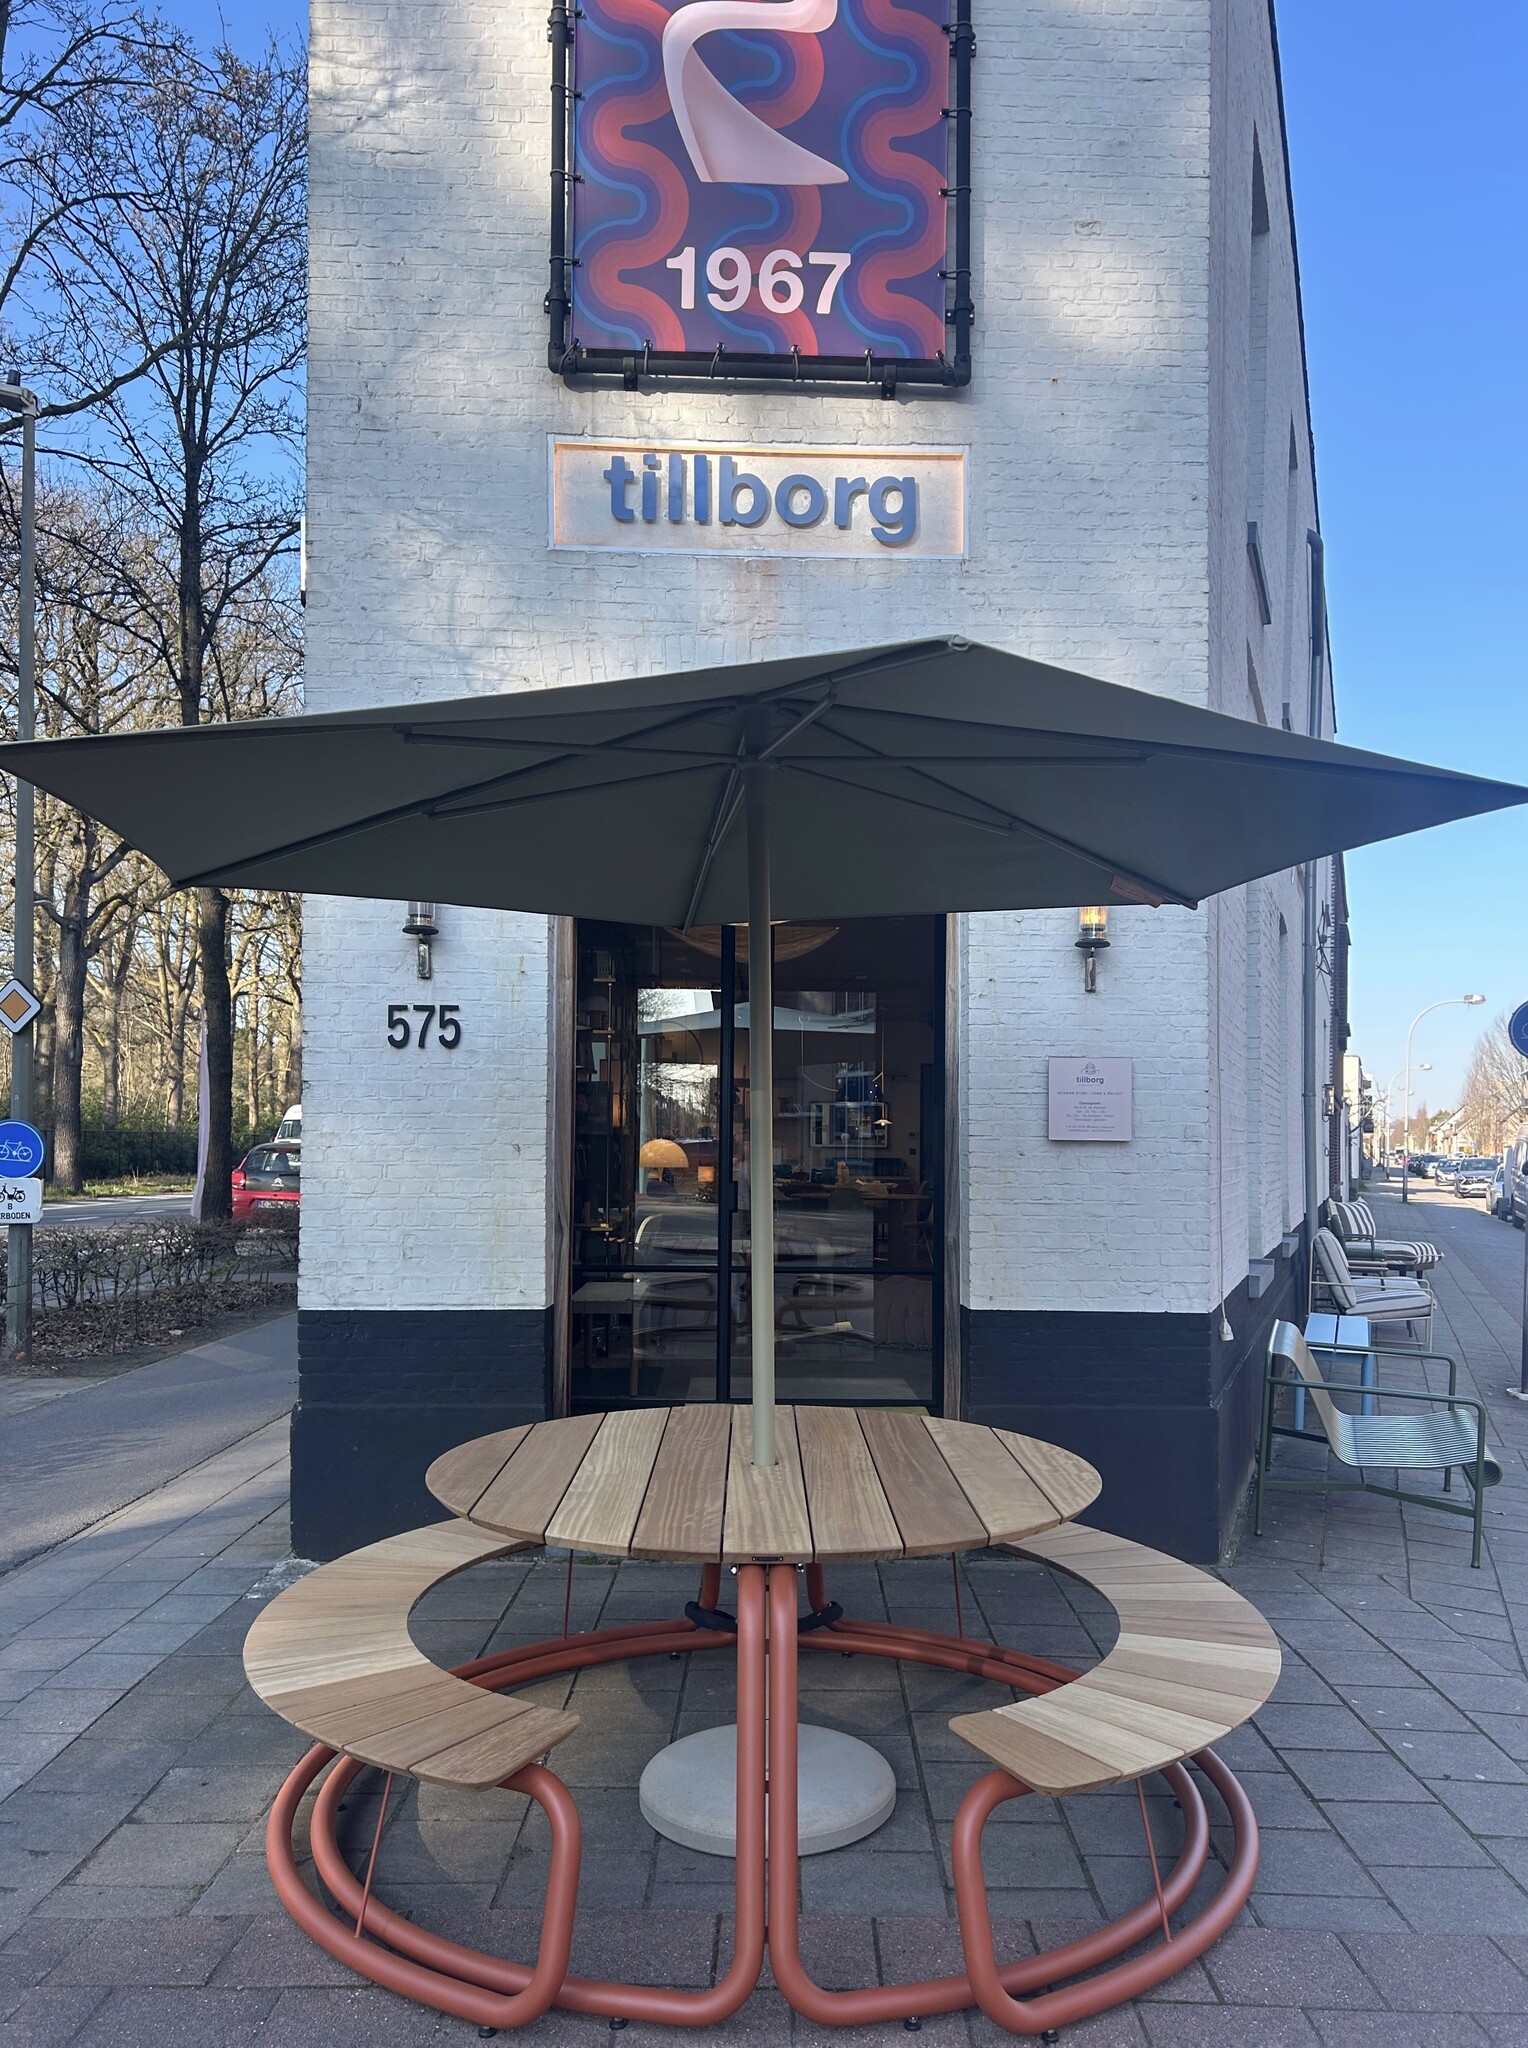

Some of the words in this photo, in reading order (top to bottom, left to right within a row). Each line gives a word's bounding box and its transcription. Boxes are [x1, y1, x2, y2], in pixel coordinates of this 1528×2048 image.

[665, 246, 852, 315] 1967
[603, 453, 917, 544] tillborg
[387, 1004, 462, 1050] 575
[1076, 1076, 1104, 1085] tillborg
[0, 1212, 31, 1220] RBODEN
